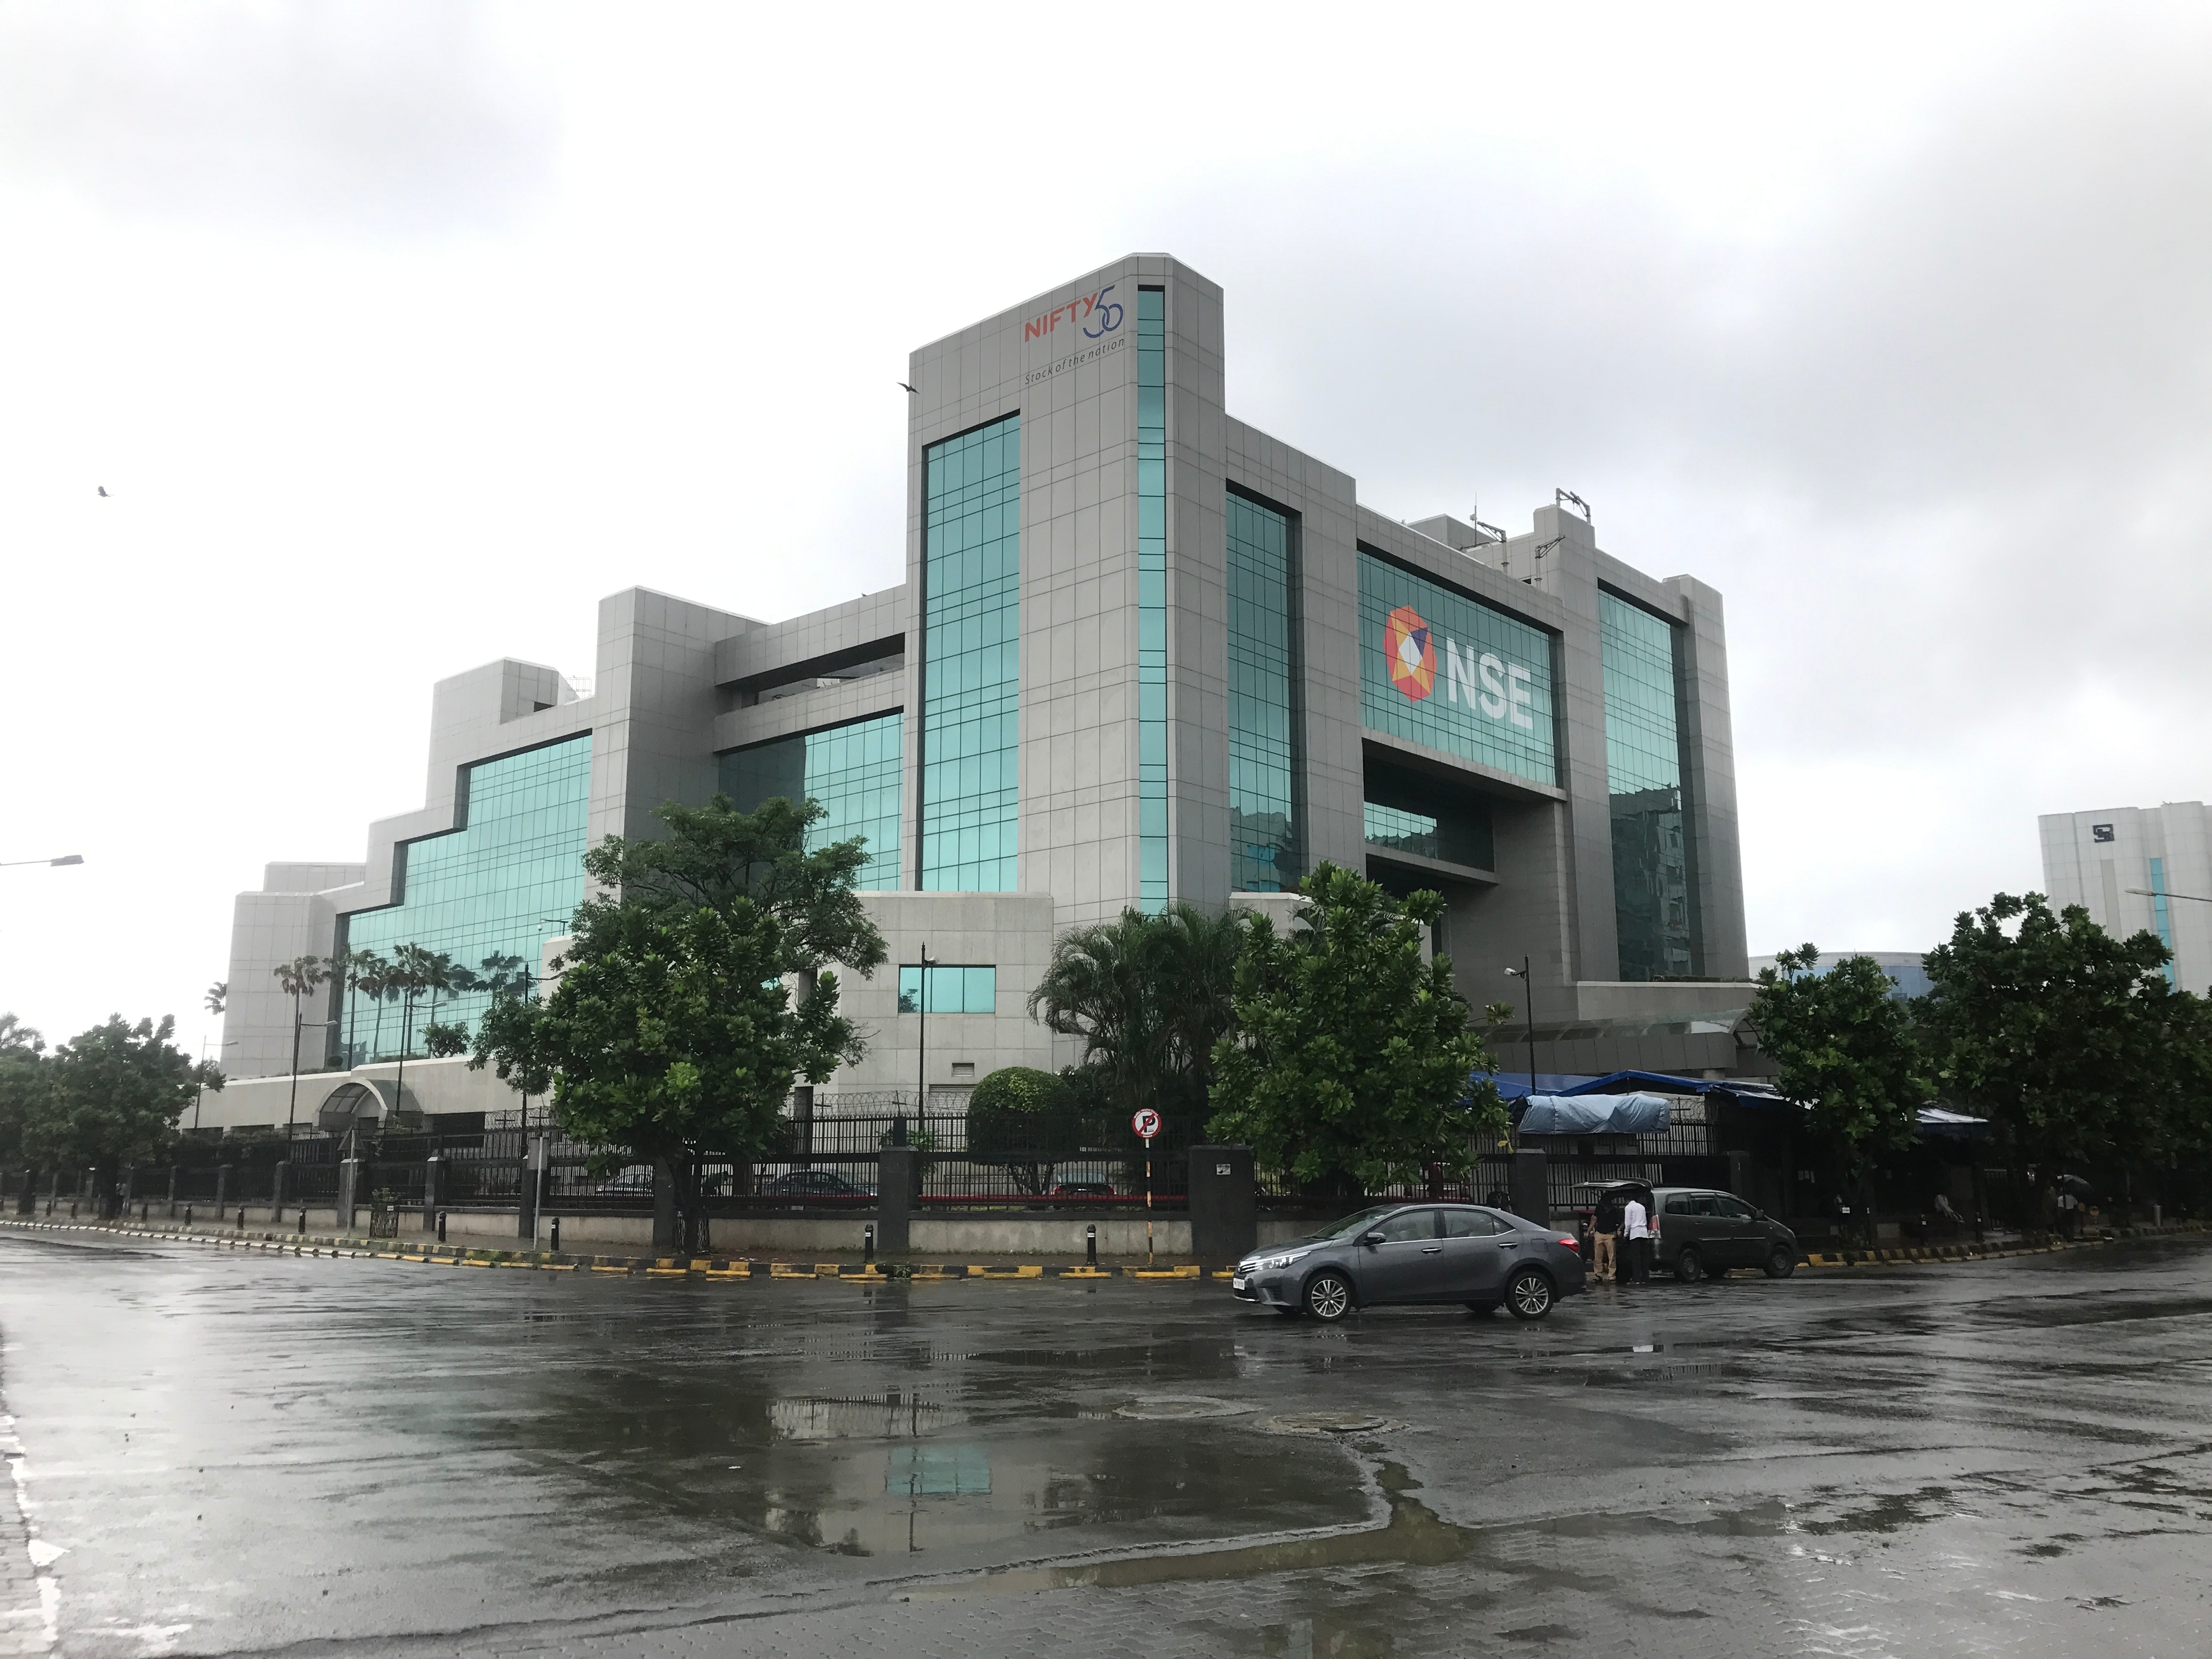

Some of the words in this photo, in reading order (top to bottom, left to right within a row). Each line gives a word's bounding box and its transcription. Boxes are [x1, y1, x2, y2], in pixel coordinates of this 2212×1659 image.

[1025, 292, 1098, 342] NIFTY
[1025, 365, 1052, 385] Stock
[1088, 338, 1124, 359] nation
[1447, 636, 1533, 730] NSE
[1143, 1115, 1155, 1132] P
